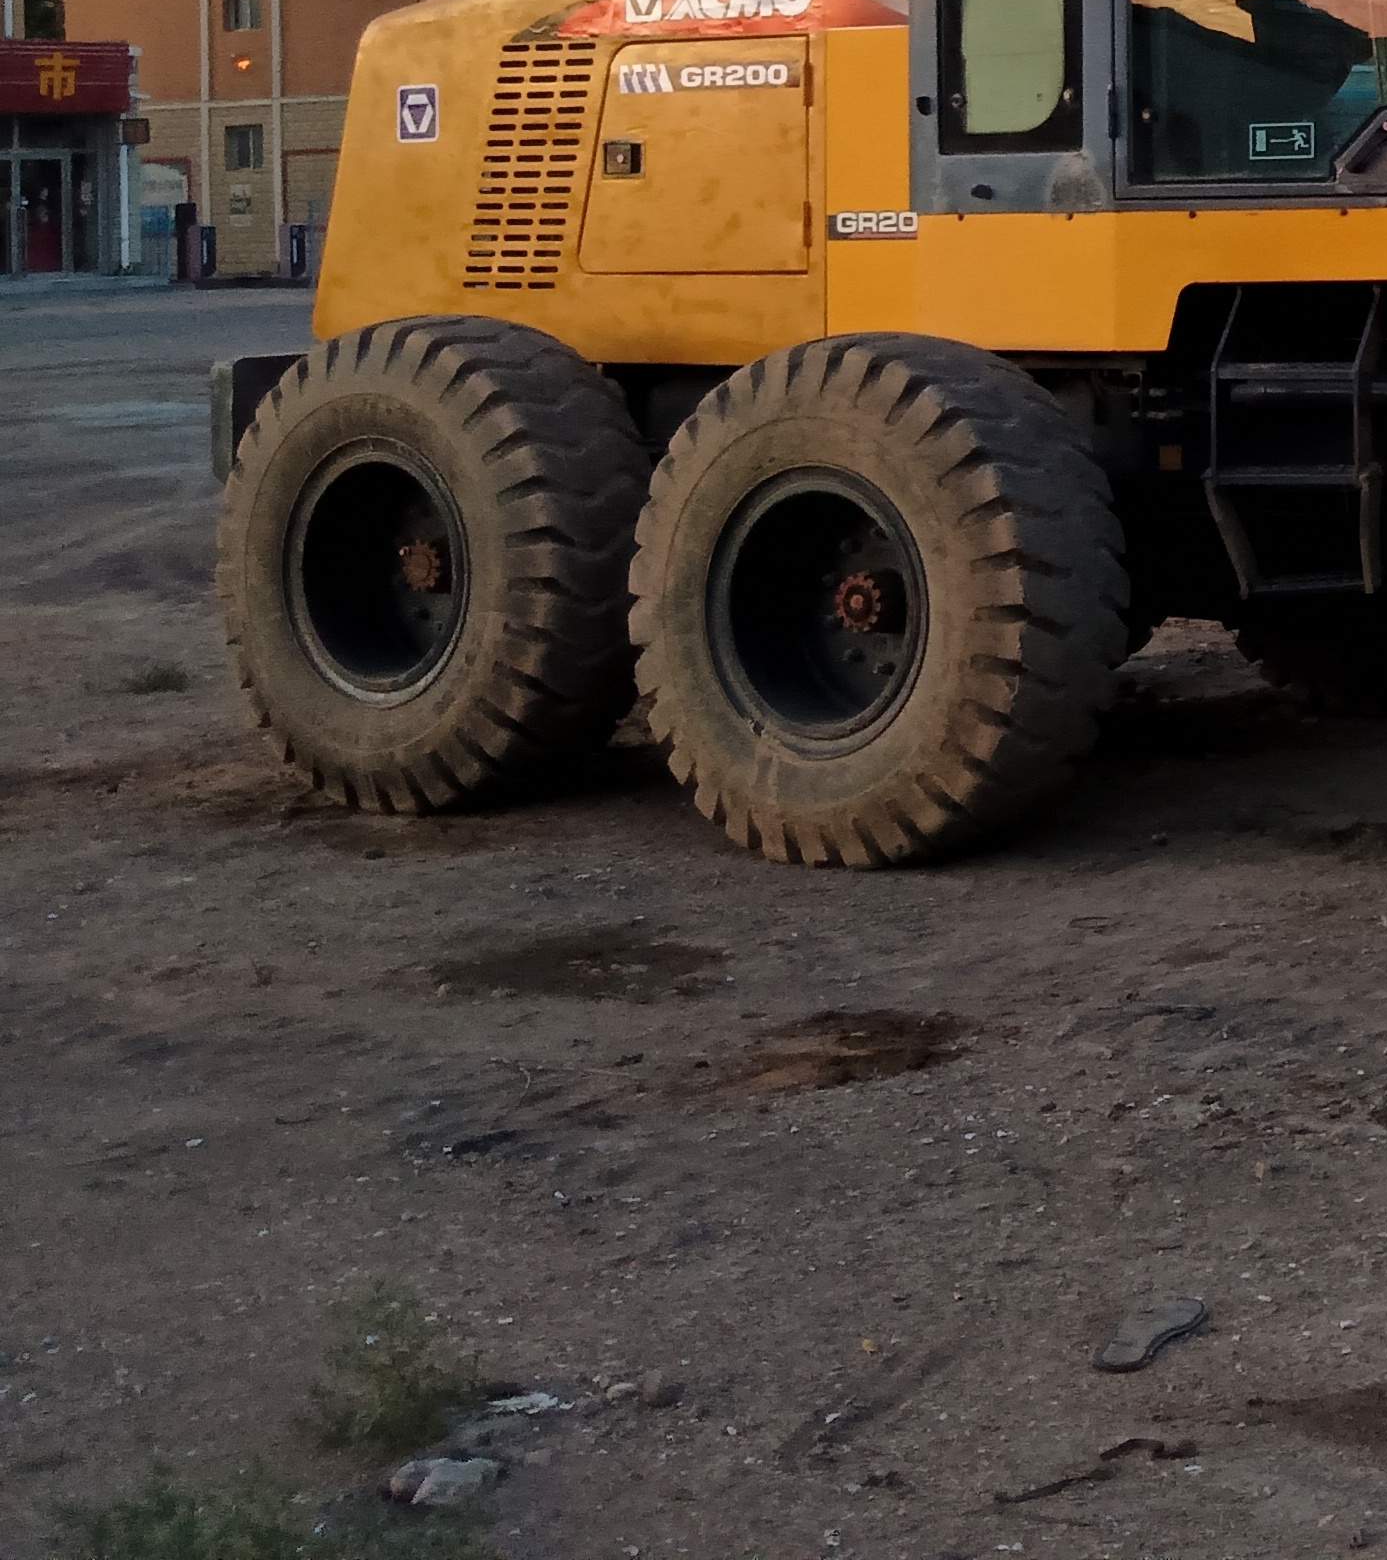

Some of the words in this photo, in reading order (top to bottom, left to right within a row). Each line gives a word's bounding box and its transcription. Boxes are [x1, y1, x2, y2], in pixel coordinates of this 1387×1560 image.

[34, 51, 81, 101] 市
[680, 63, 789, 87] GR200
[836, 211, 919, 233] GR20
